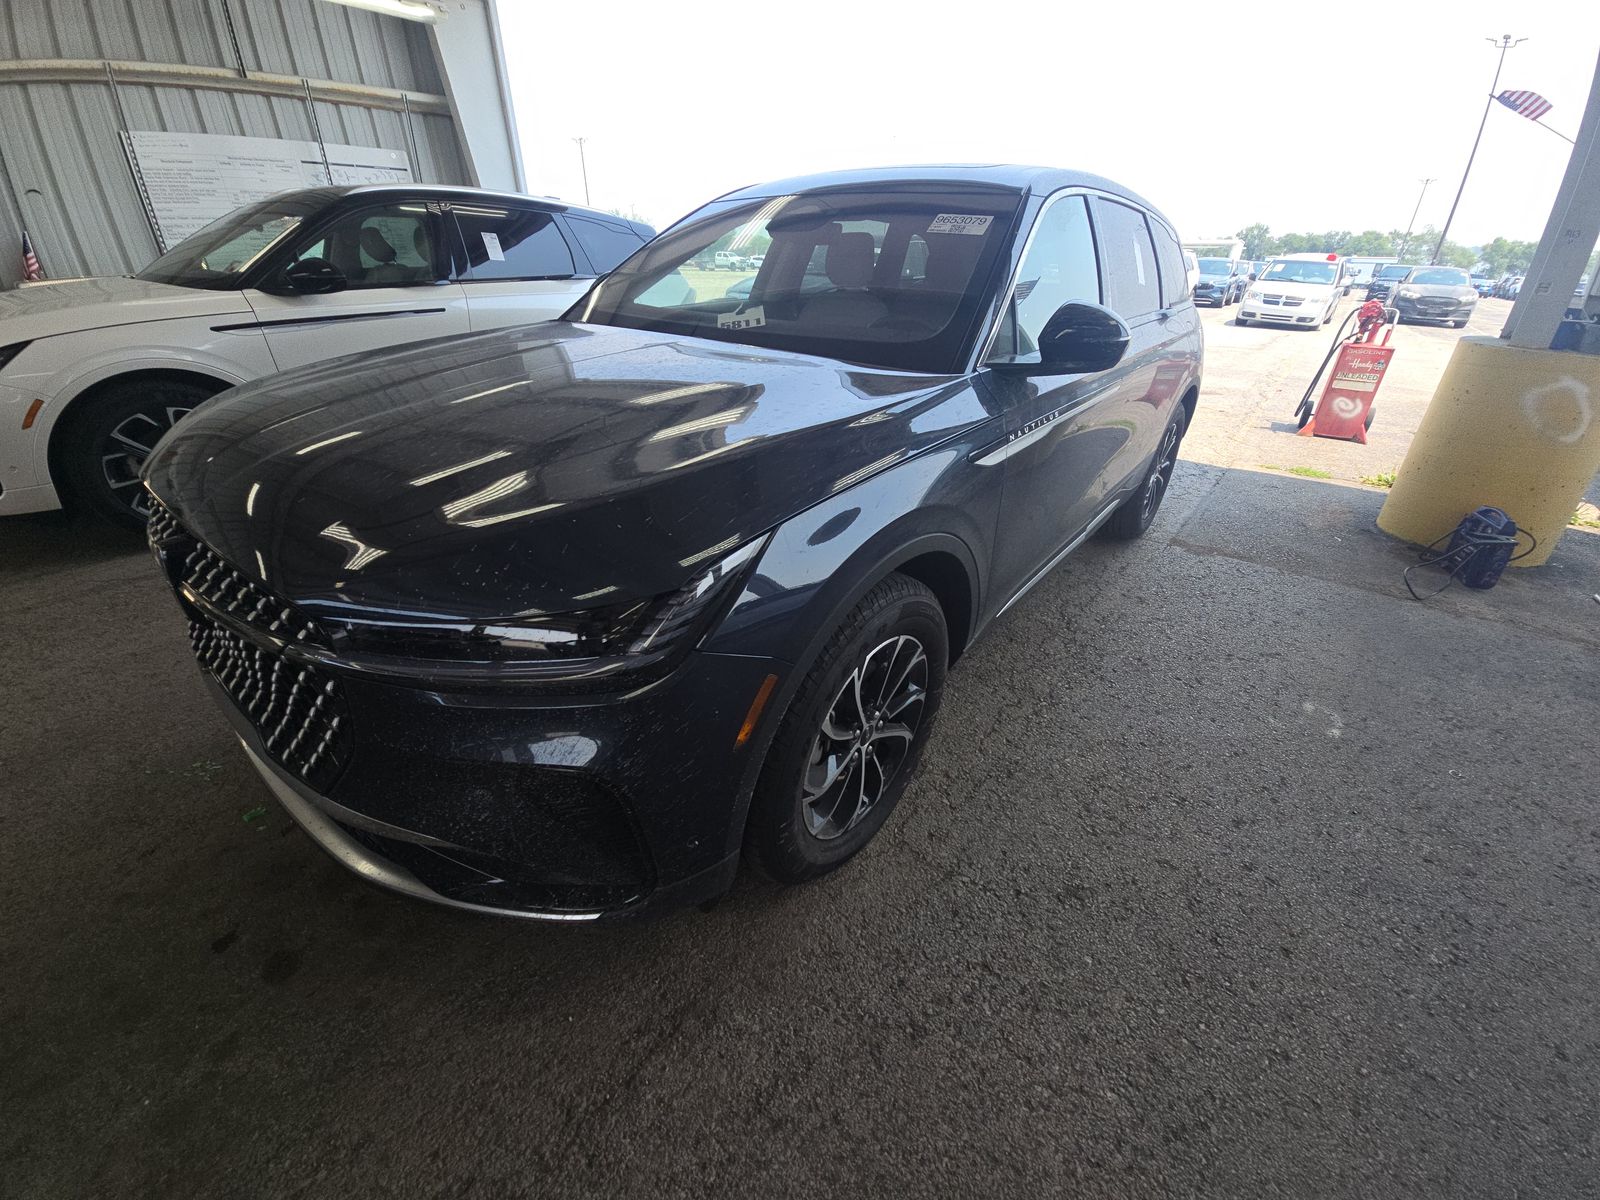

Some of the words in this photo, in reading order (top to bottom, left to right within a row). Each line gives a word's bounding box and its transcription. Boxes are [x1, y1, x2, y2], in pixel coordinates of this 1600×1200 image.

[935, 215, 988, 226] 9653079
[1337, 371, 1380, 381] UNLEADED
[1009, 411, 1060, 441] NAUTILUS
